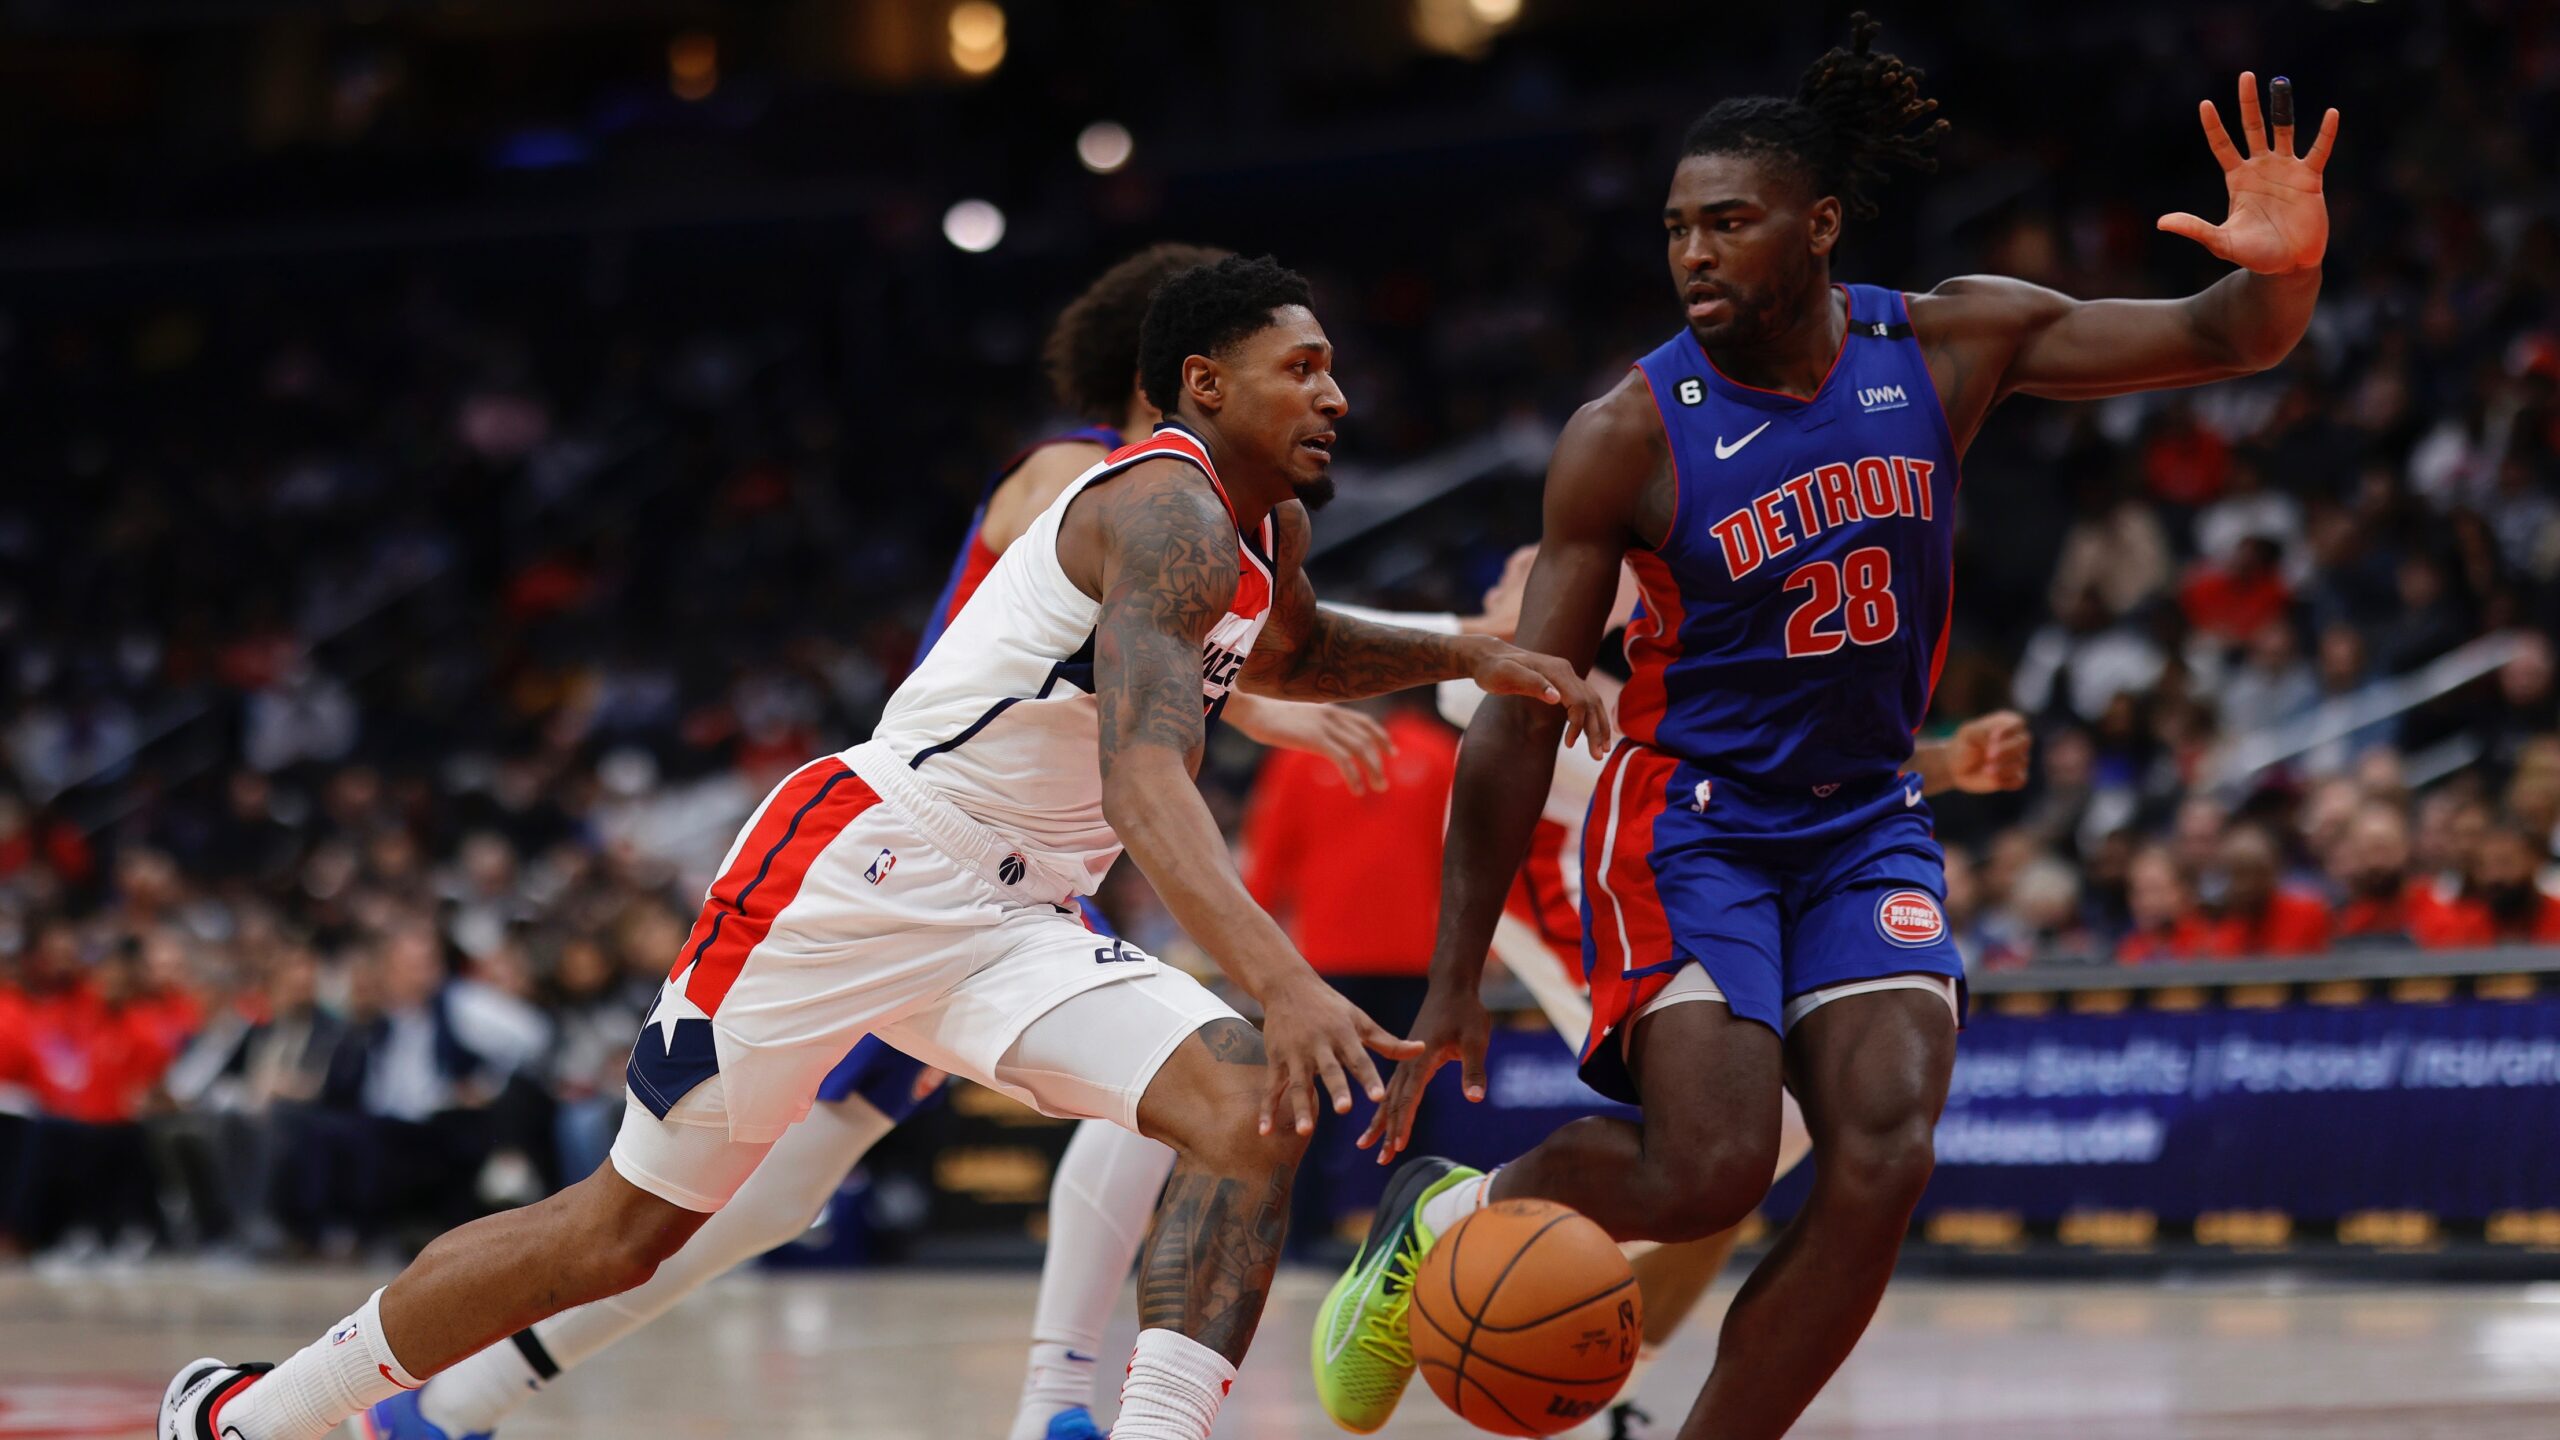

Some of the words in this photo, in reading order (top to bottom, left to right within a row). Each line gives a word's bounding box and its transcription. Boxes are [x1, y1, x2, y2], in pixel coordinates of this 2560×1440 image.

[1680, 379, 1702, 405] 6
[1857, 384, 1907, 407] UWM
[1709, 456, 1934, 582] DETROIT
[1783, 547, 1898, 658] 28
